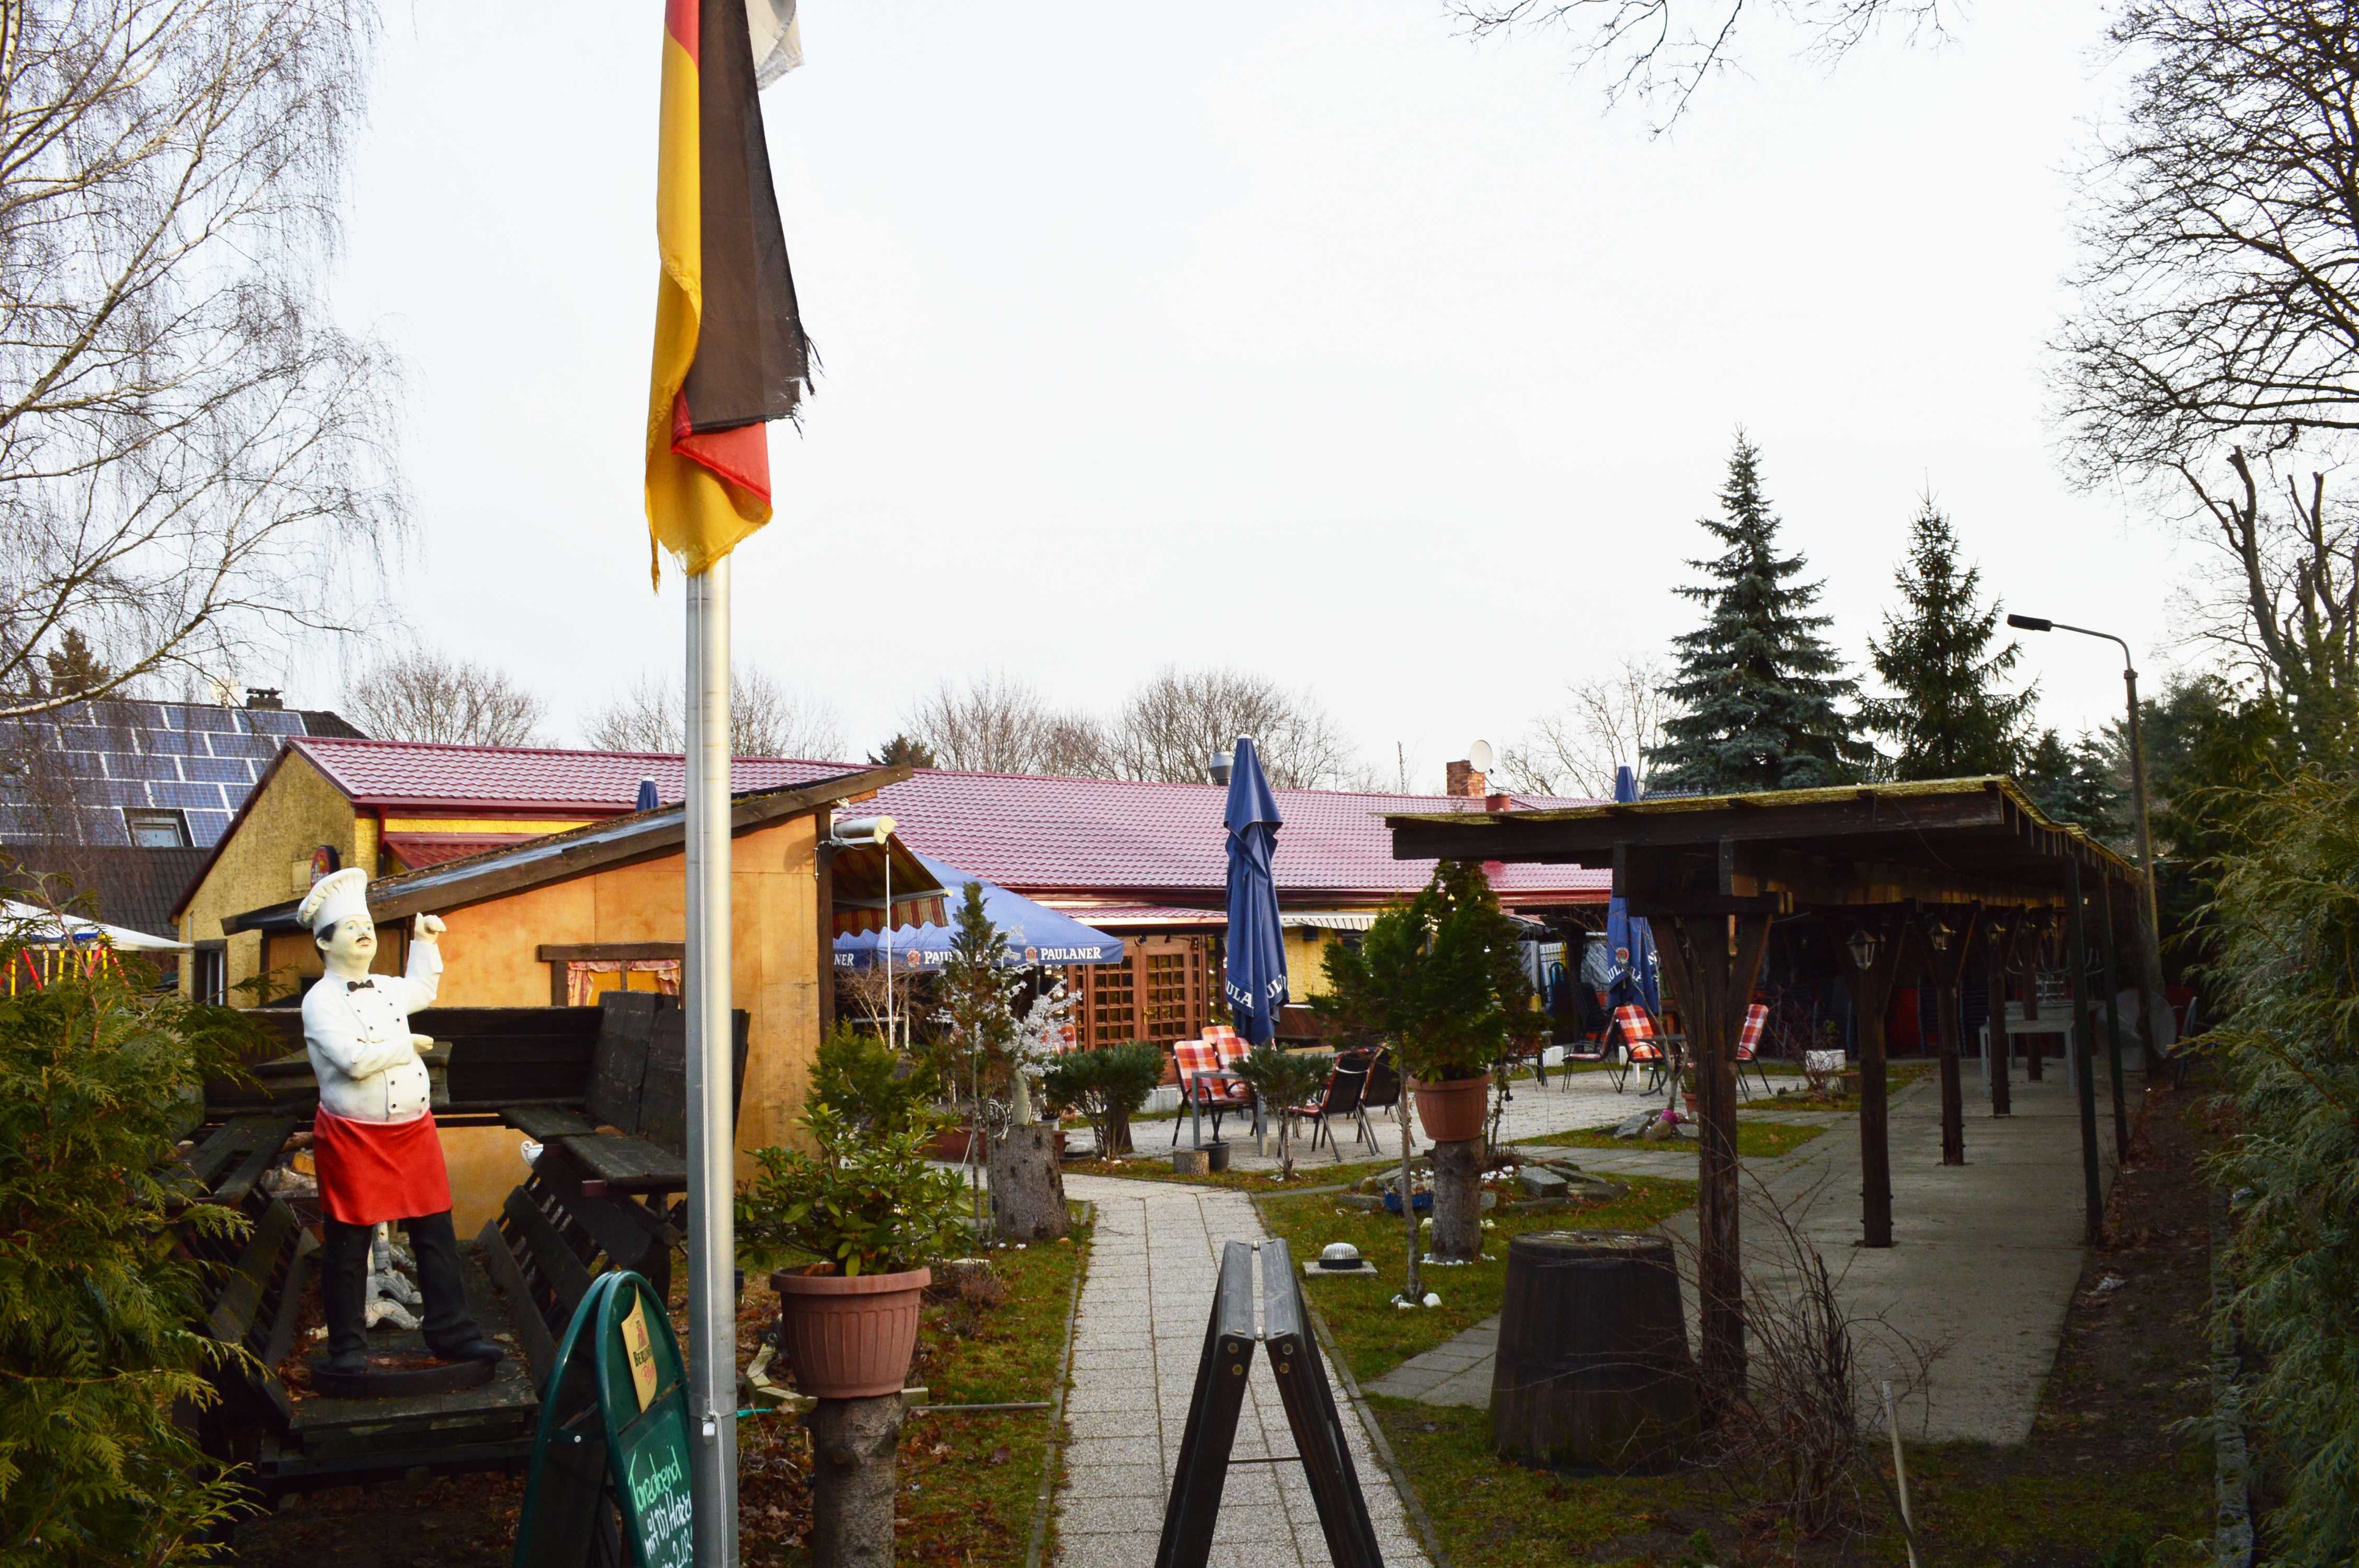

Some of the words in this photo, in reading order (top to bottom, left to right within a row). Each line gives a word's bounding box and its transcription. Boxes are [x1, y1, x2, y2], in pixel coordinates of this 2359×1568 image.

[1040, 947, 1102, 961] PAULANER
[1226, 978, 1254, 1009] ULA
[628, 1445, 682, 1516] Tanzabend
